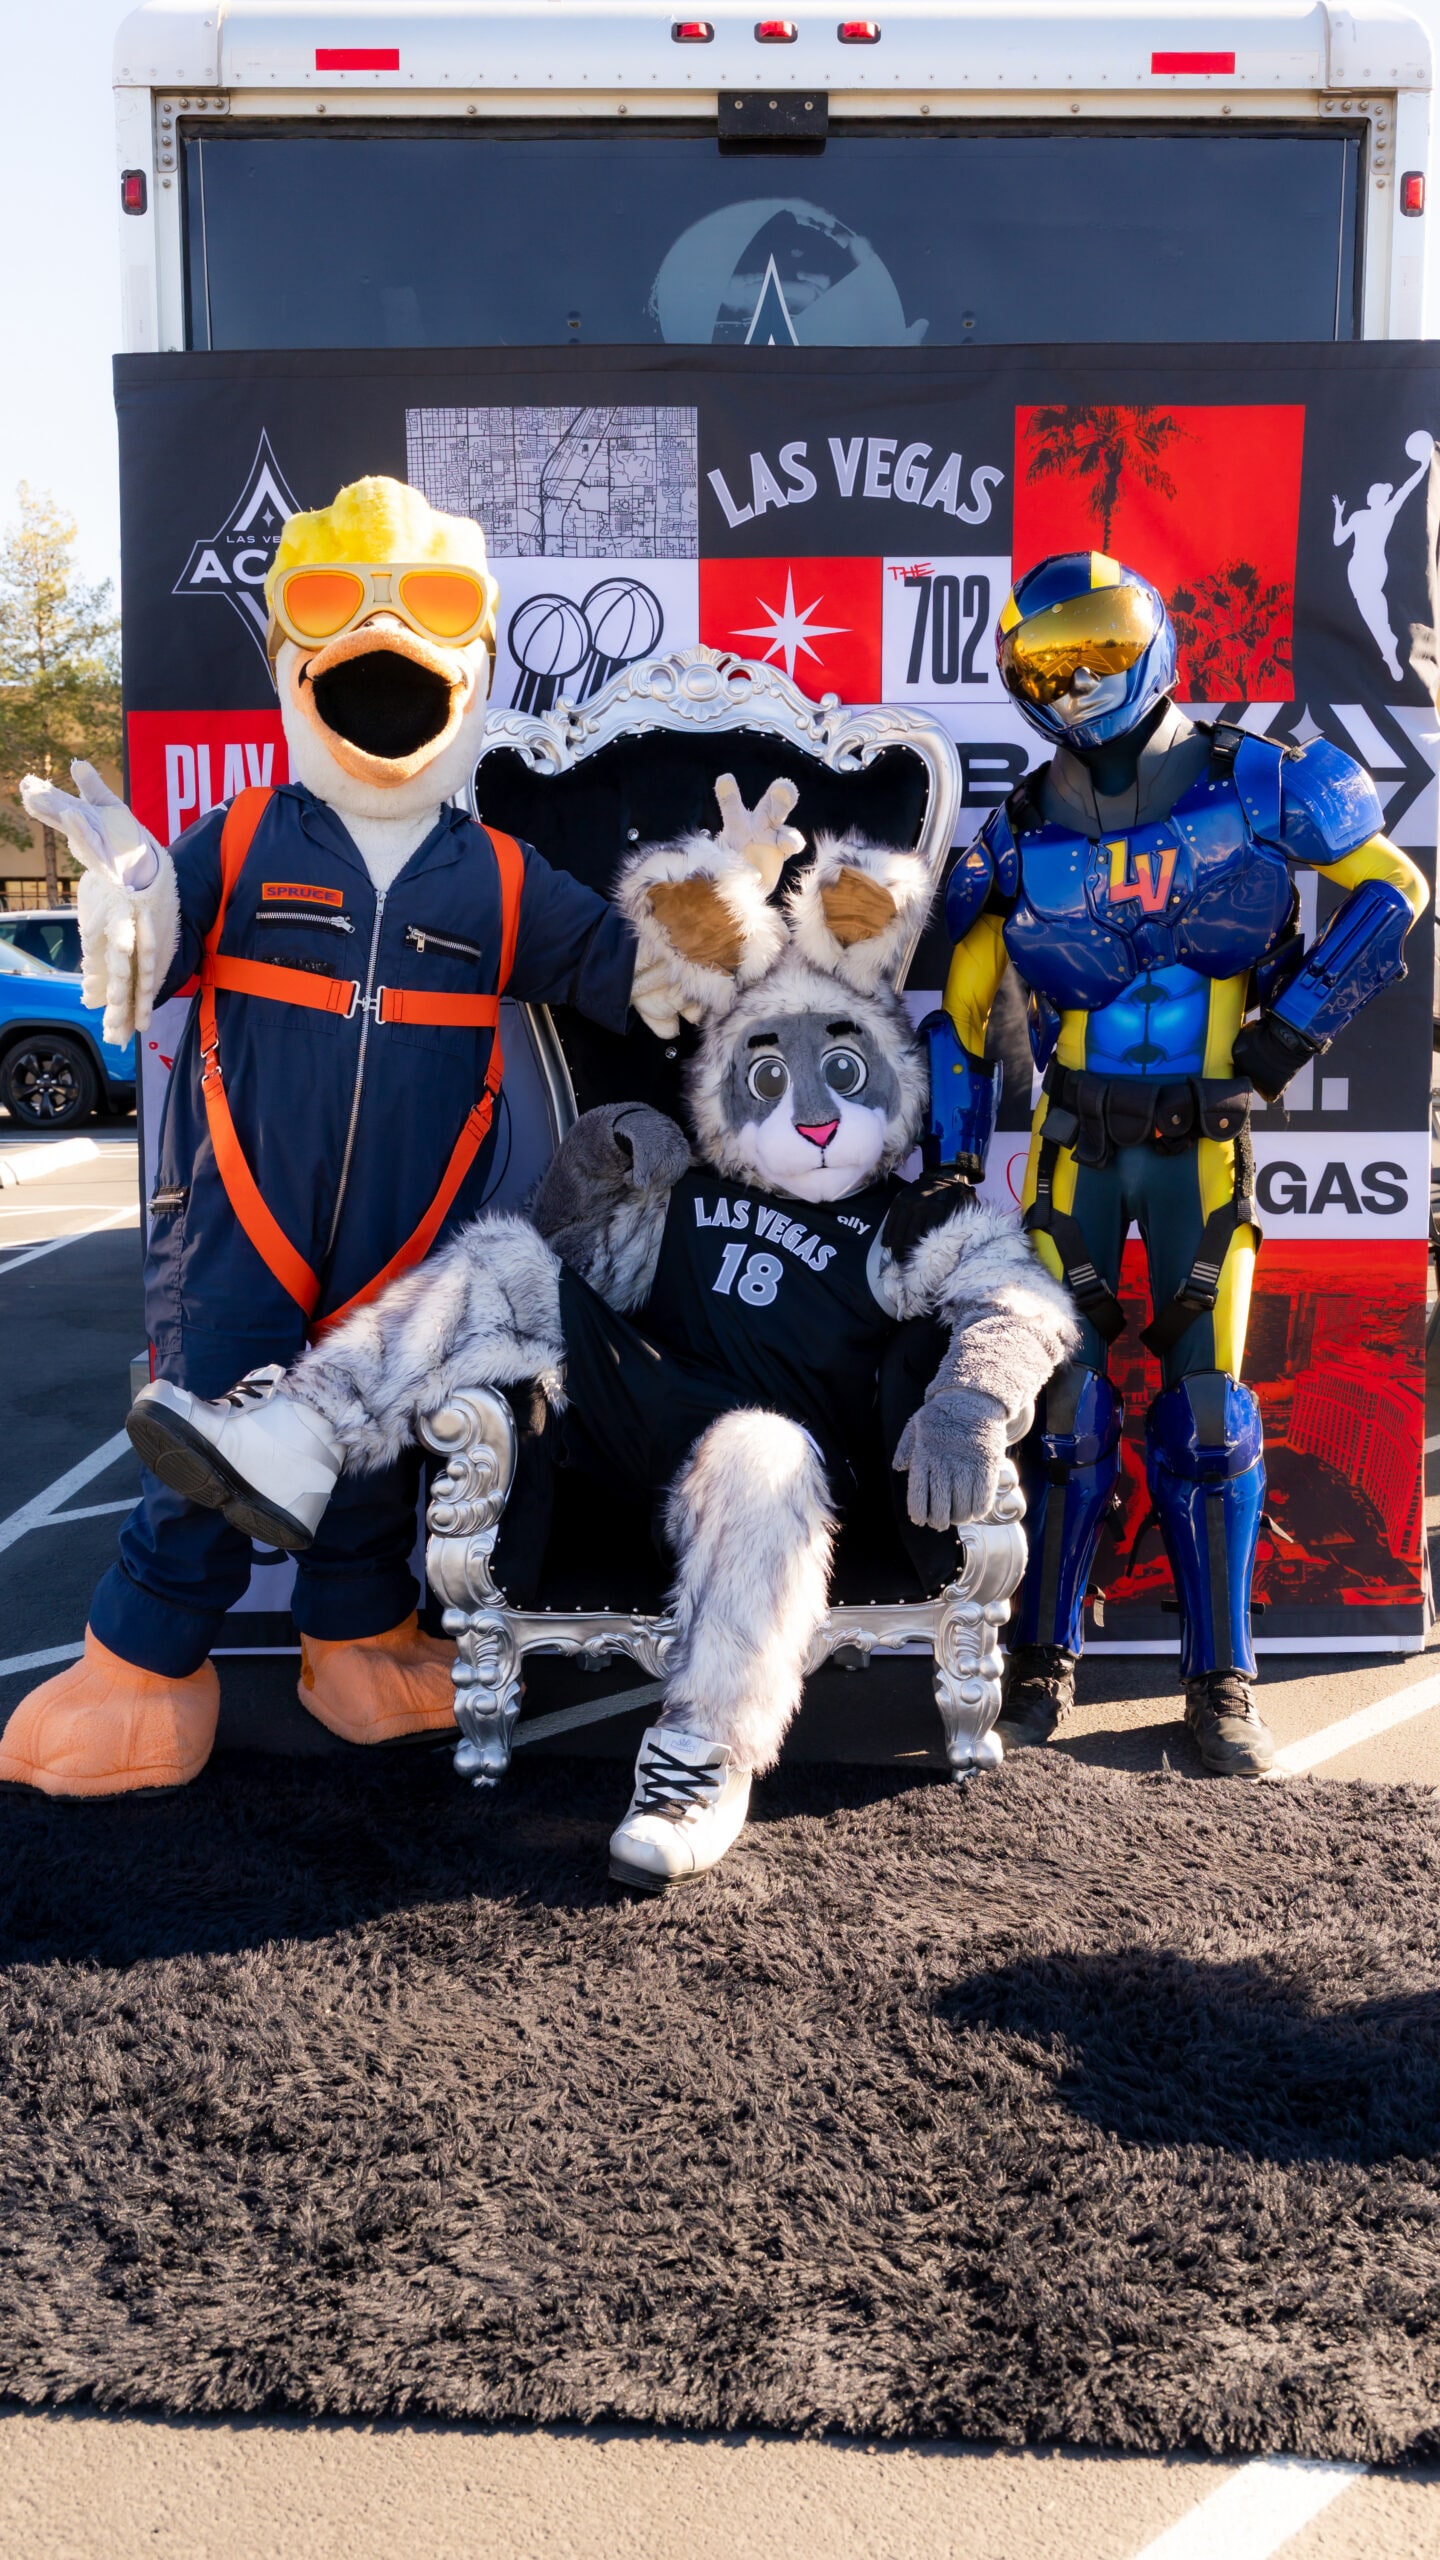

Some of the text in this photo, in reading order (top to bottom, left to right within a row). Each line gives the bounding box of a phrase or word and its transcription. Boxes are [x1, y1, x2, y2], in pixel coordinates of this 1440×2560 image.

[706, 437, 1006, 529] LAS VEGAS
[189, 548, 270, 585] AC
[226, 535, 281, 544] LAS VE
[887, 562, 936, 581] THE
[903, 574, 991, 685] 702
[266, 886, 337, 901] SPRUCE
[1100, 836, 1181, 917] LV
[1253, 1160, 1410, 1215] GAS
[694, 1197, 838, 1272] LAS VEGAS
[836, 1214, 872, 1236] ally
[711, 1242, 784, 1307] 18
